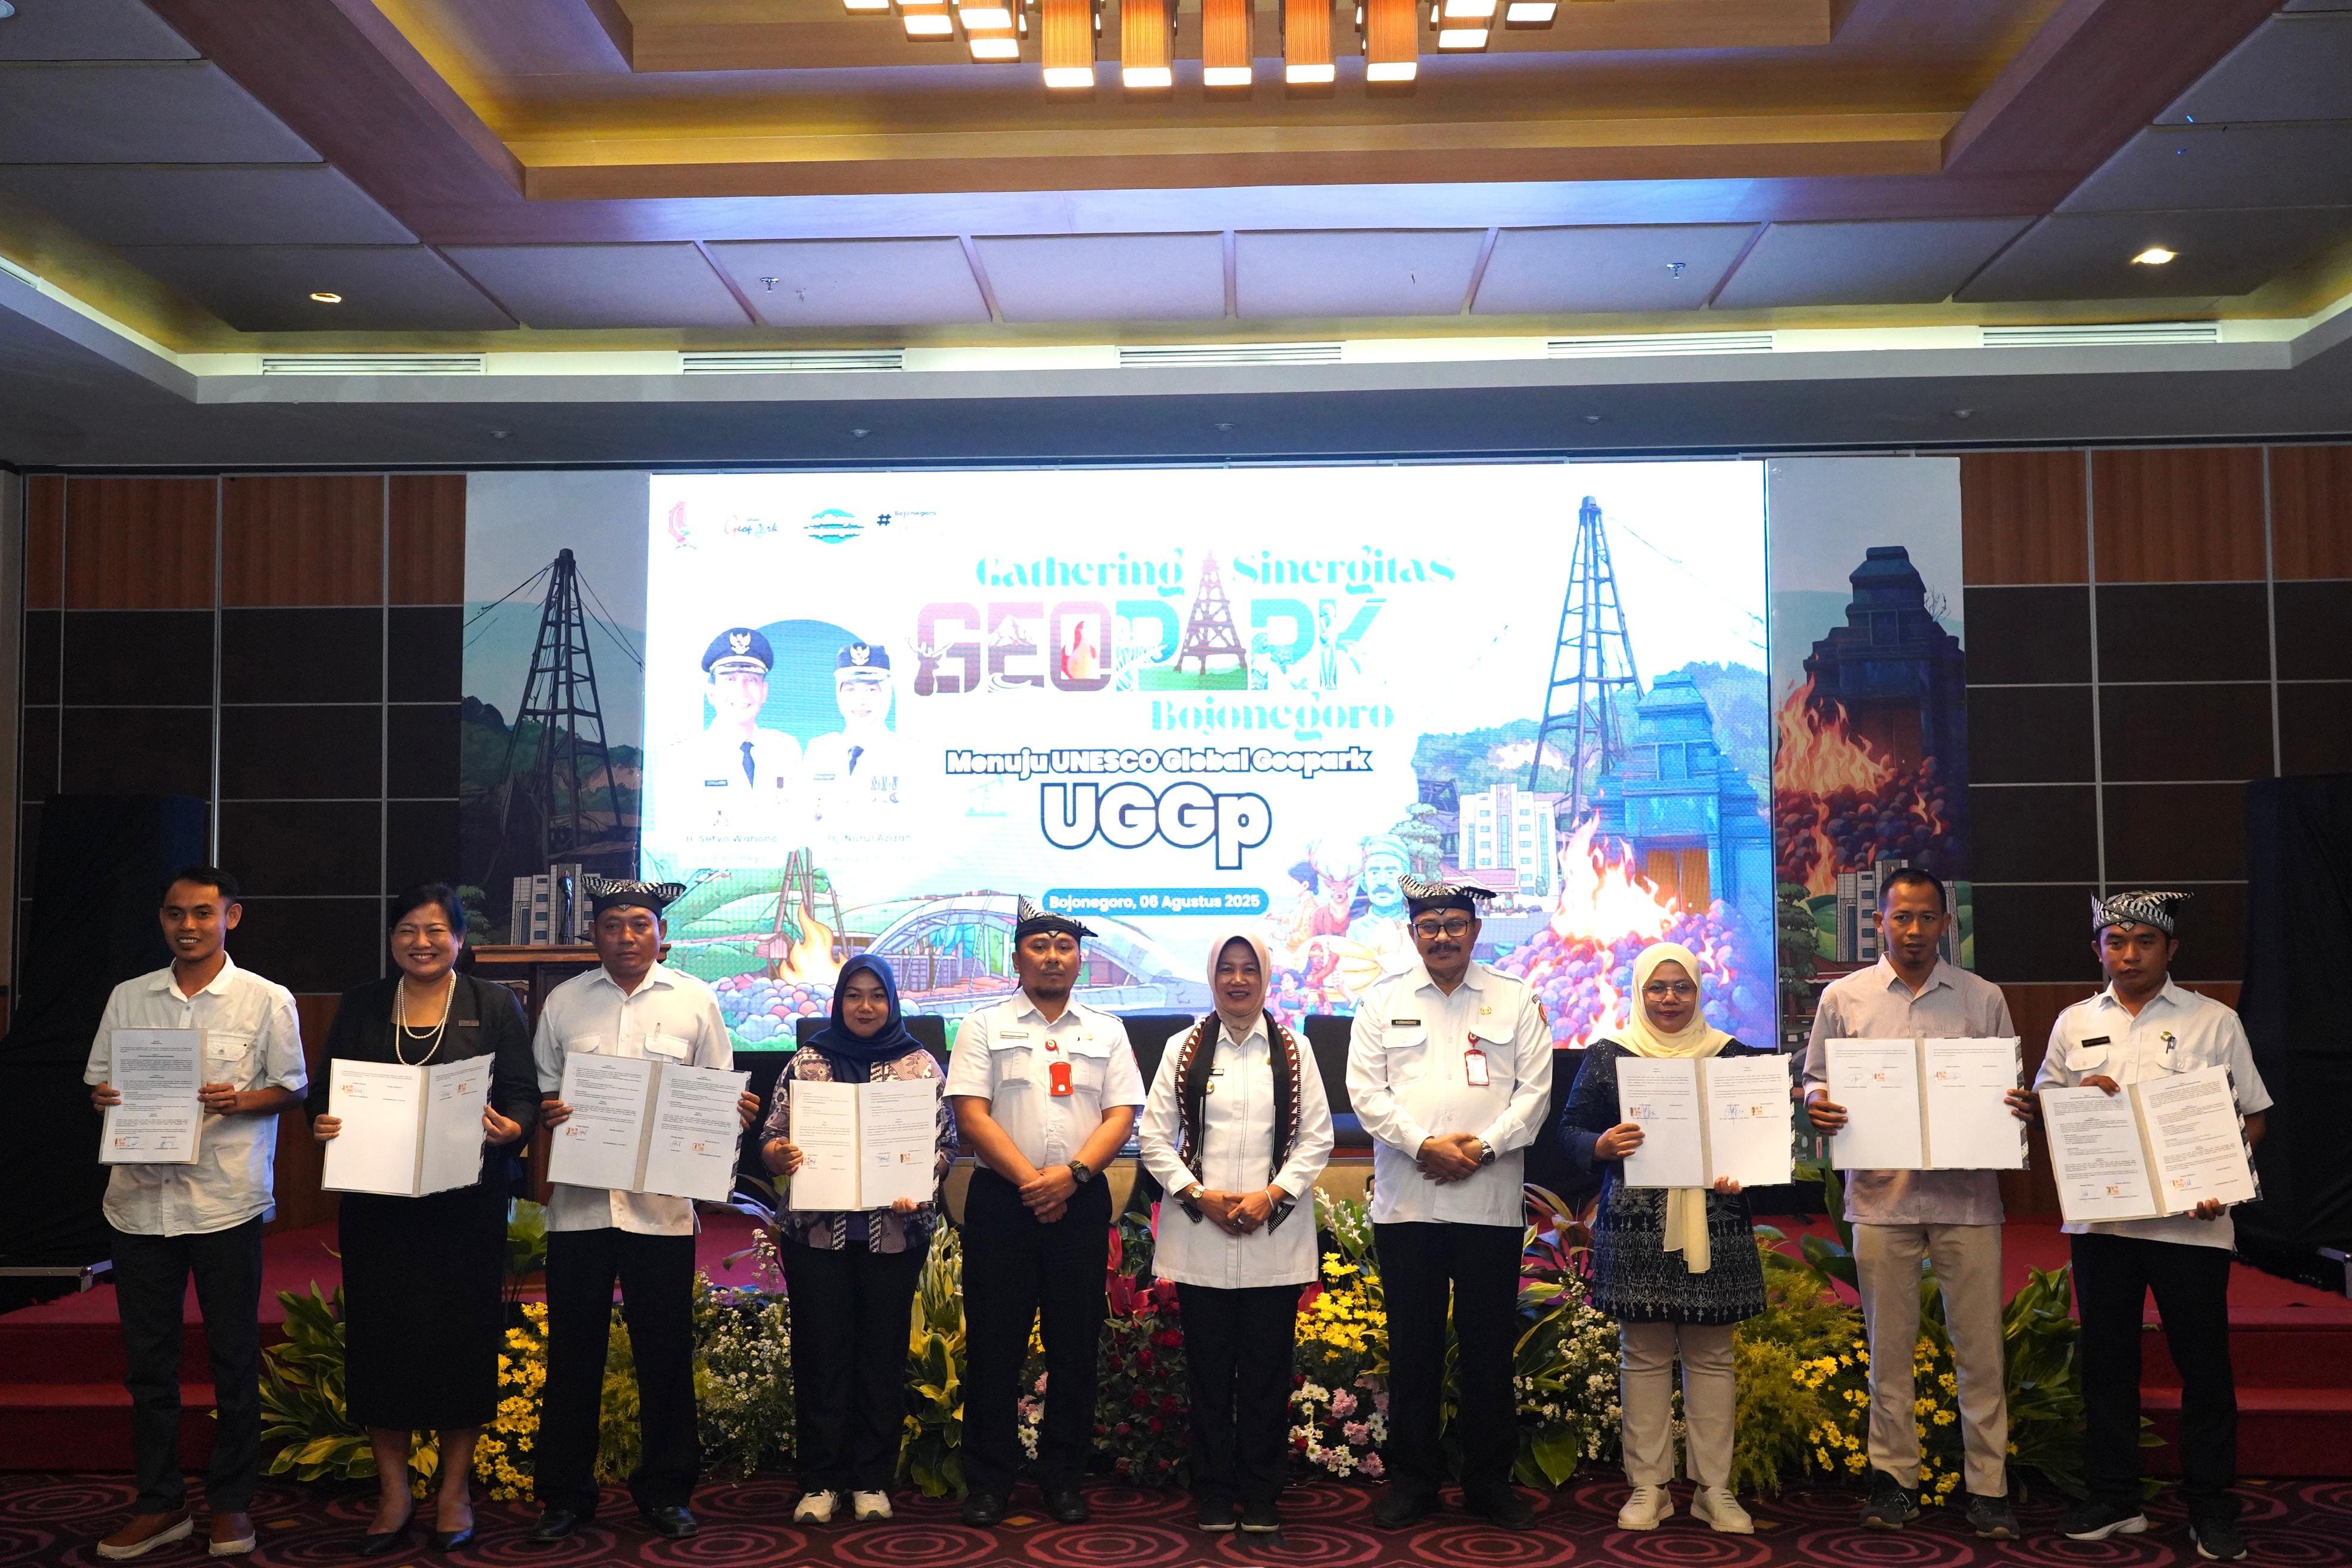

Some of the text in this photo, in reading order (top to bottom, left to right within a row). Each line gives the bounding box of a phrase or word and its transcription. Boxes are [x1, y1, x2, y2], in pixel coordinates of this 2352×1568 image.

[976, 544, 1456, 597] Gathering Sinergitas
[913, 550, 1388, 697] GEOPARK
[1151, 691, 1394, 742] Bojonegoro
[946, 746, 1373, 780] Menuju UNESCO Global Geopark
[1040, 781, 1272, 870] UGGp
[1049, 894, 1261, 912] Bojonegoro, 06 Agustus 2025
